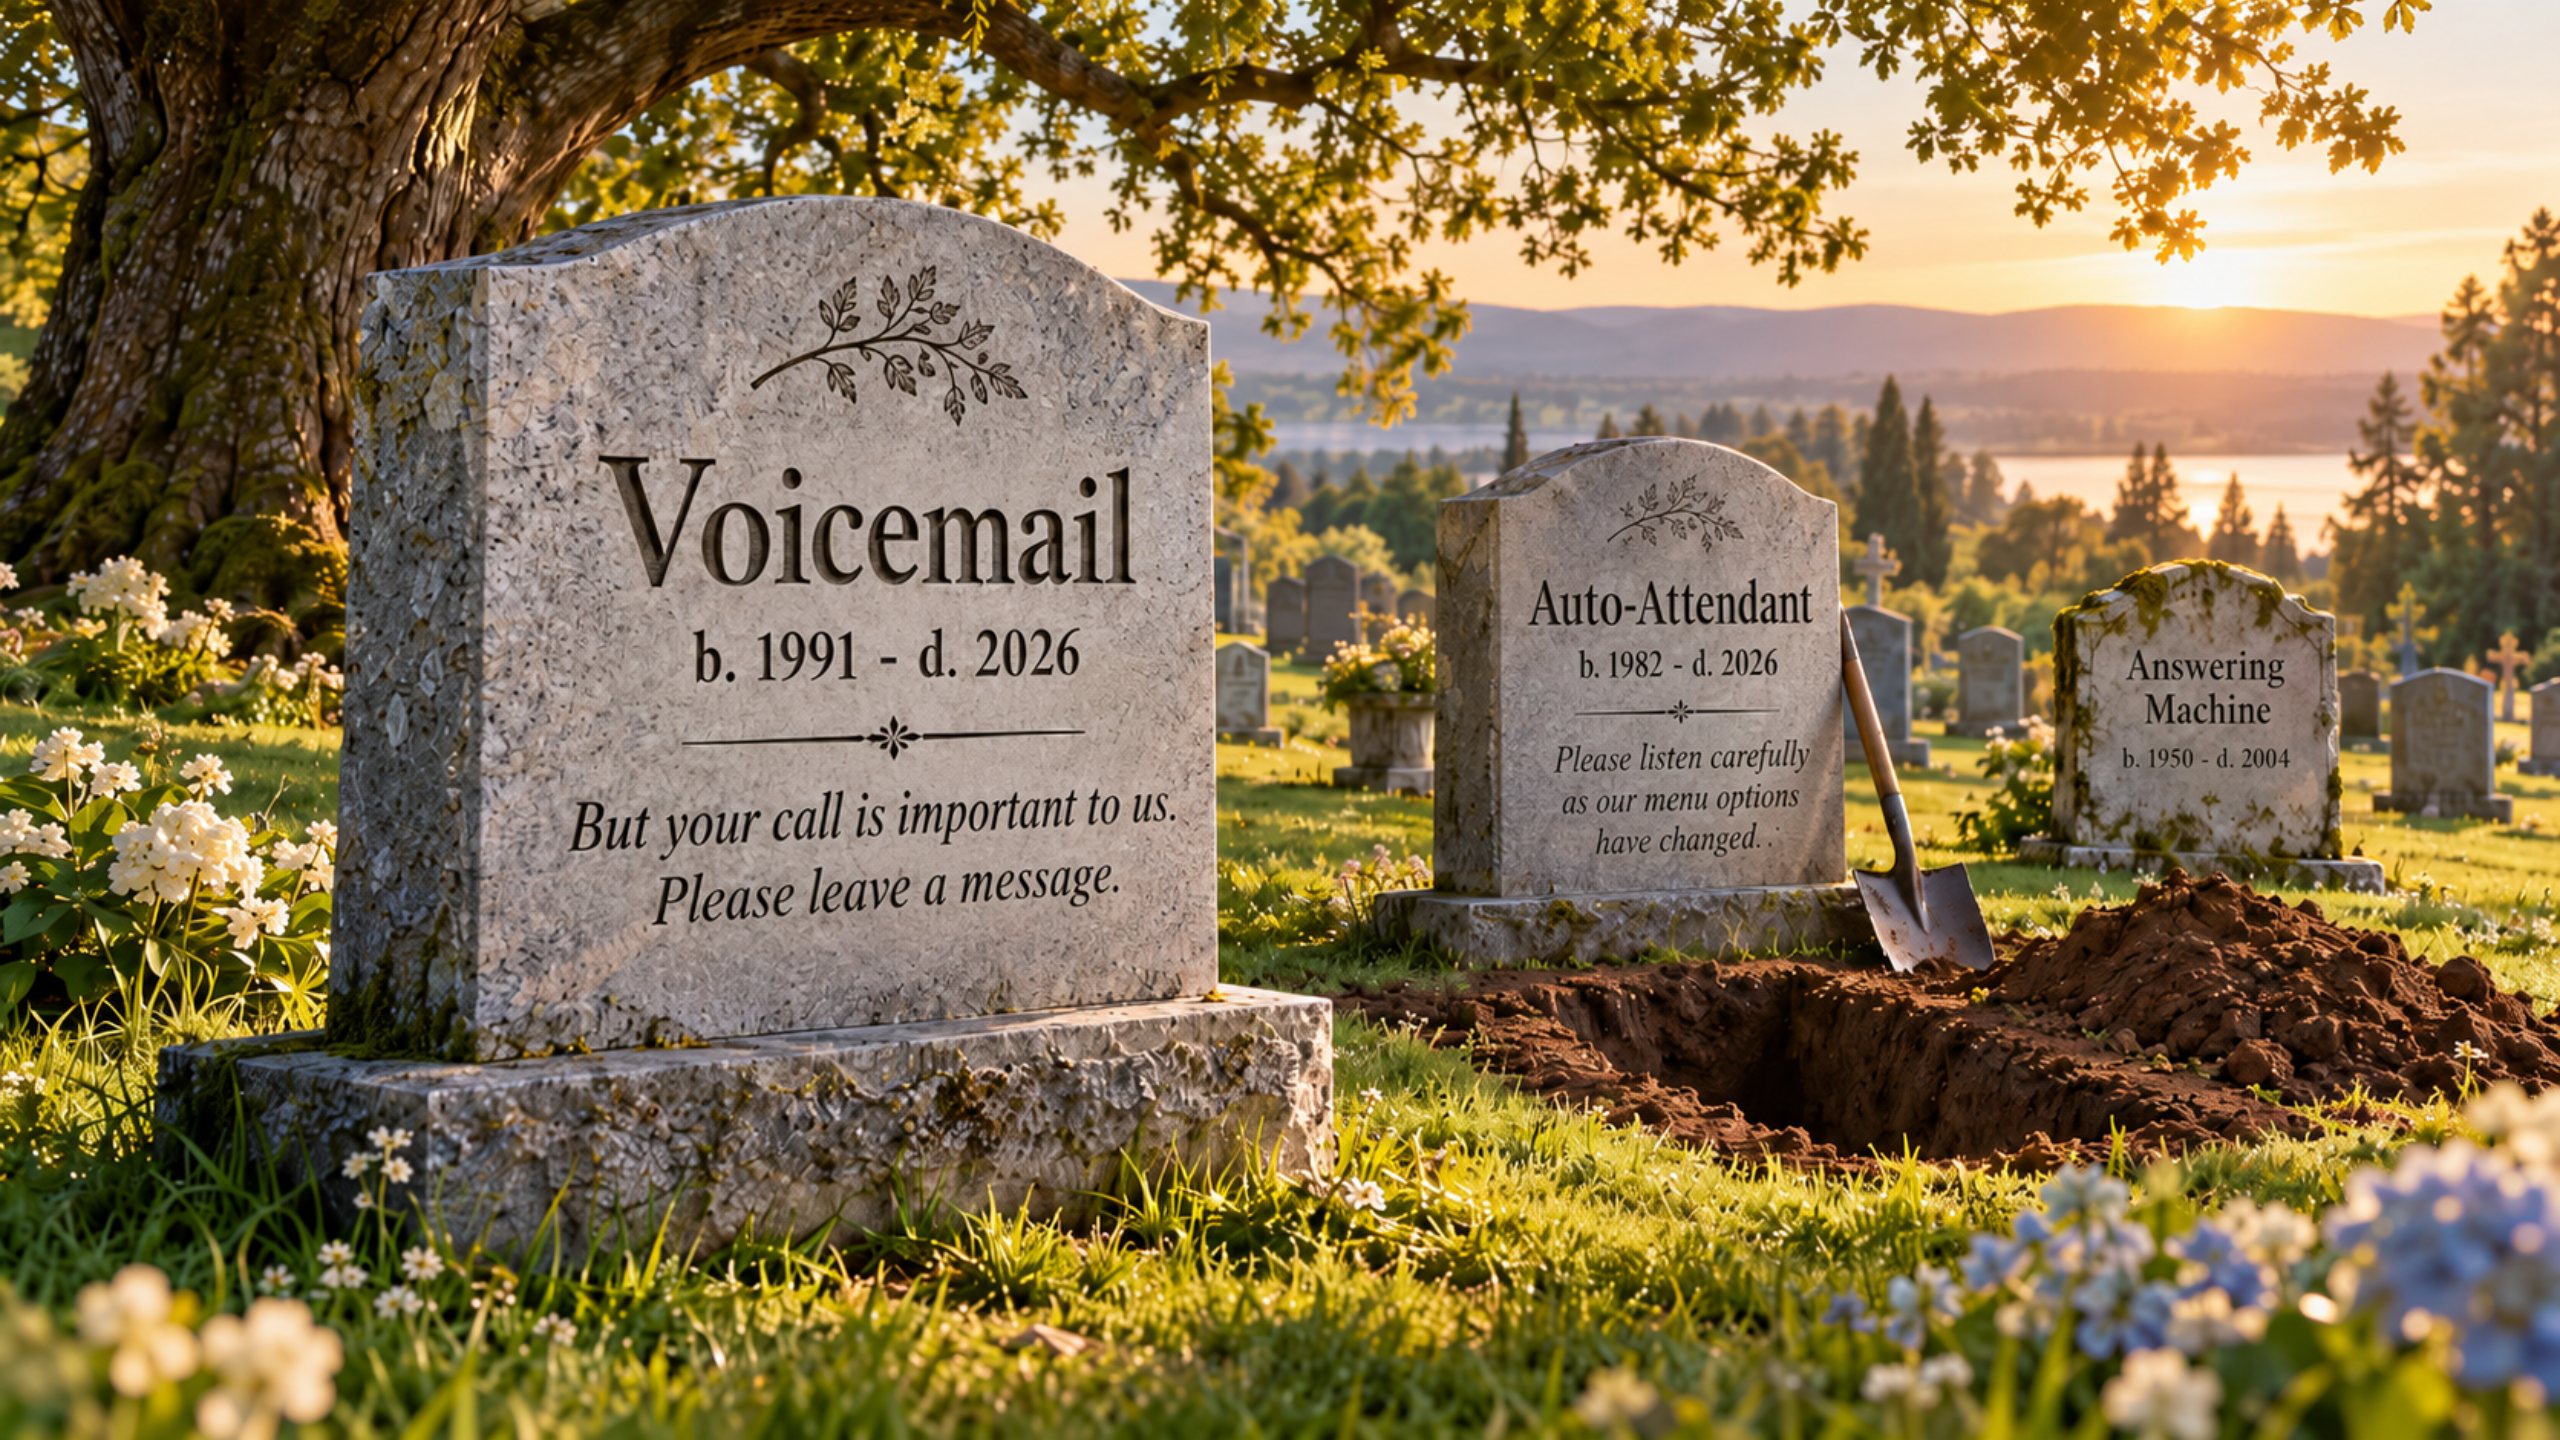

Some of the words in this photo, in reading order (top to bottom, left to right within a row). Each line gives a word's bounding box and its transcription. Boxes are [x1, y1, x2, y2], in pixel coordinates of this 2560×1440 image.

[597, 454, 1137, 588] Voicemail
[1527, 578, 1813, 626] Auto-Attendant
[693, 629, 736, 683] b.
[758, 631, 857, 682] 1991
[919, 627, 957, 678] d.
[975, 627, 1080, 677] 2026
[1579, 649, 1600, 679] b.
[1609, 650, 1663, 679] 1982
[1692, 648, 1713, 677] d.
[1721, 648, 1778, 676] 2026
[2126, 649, 2285, 689] Answering
[2145, 692, 2271, 725] Machine
[1554, 744, 1632, 774] Please
[1640, 742, 1702, 771] listen
[1710, 739, 1811, 775] carefully
[2122, 747, 2140, 769] b.
[2149, 747, 2194, 769] 1950
[2216, 747, 2234, 769] d.
[2241, 748, 2290, 769] 2004
[1562, 795, 1589, 815] as
[1596, 794, 1638, 814] our
[1644, 792, 1708, 812] menu
[1716, 783, 1800, 817] options
[568, 801, 651, 852] But
[659, 810, 762, 861] your
[772, 790, 844, 842] call
[856, 792, 886, 838] is
[898, 789, 1078, 845] important
[1088, 788, 1120, 826] to
[1133, 792, 1176, 823] us.
[1595, 827, 1652, 855] have
[652, 872, 795, 926] Please
[809, 867, 911, 915] leave
[924, 874, 947, 906] a
[960, 863, 1120, 907] message.
